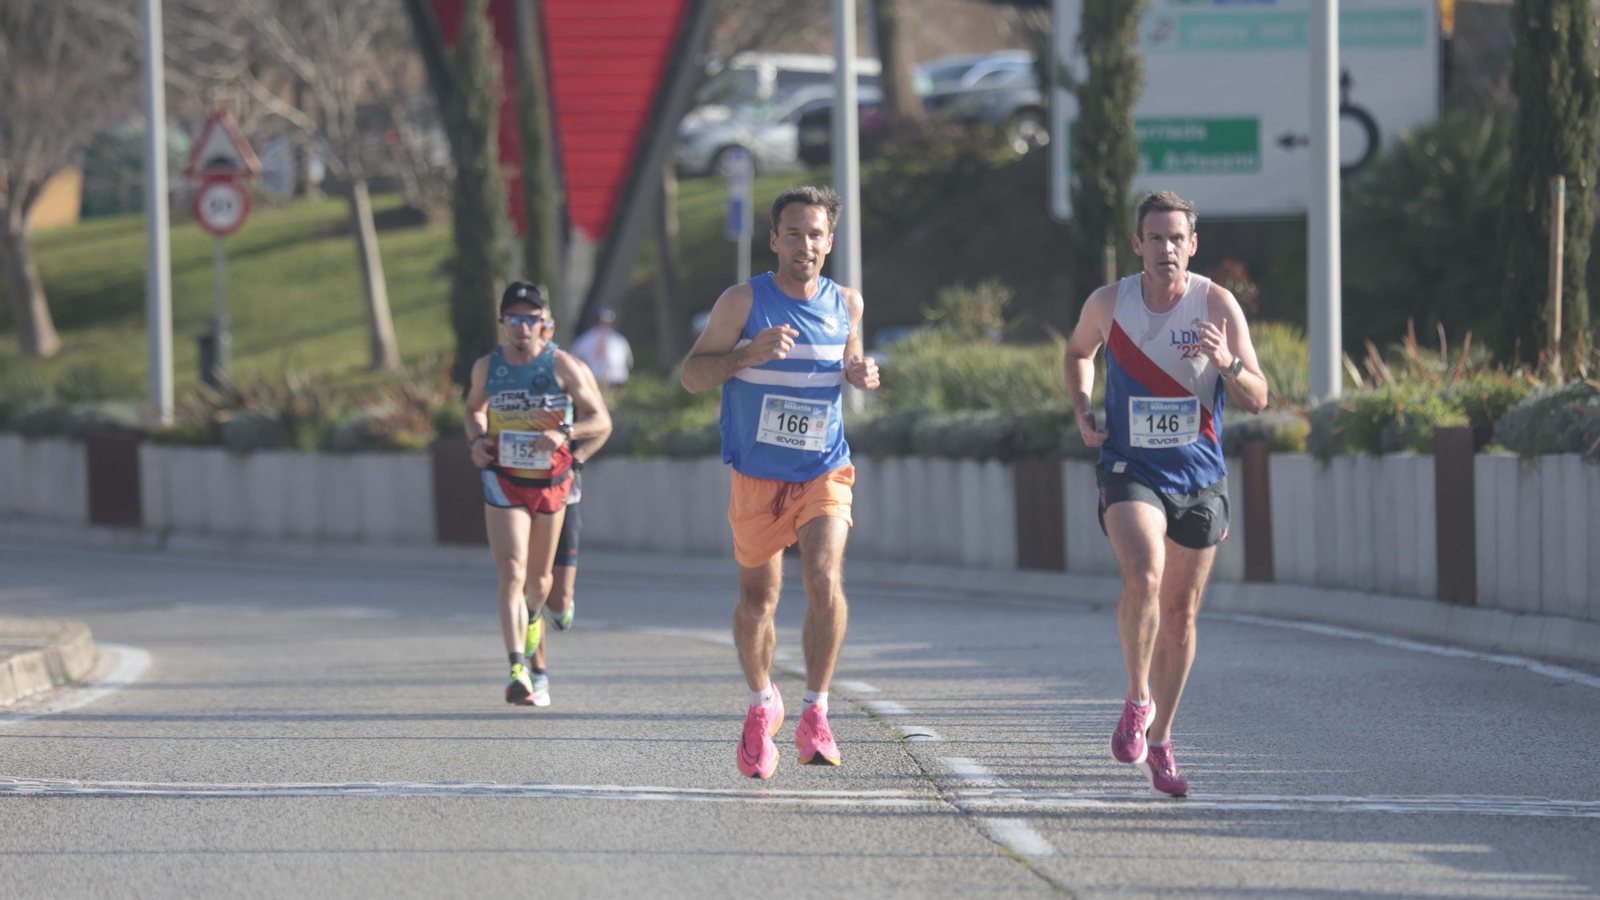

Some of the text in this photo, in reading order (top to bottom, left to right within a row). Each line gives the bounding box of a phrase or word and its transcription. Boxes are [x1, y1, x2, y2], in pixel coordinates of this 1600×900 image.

[777, 413, 809, 434] 166
[1146, 414, 1179, 433] 146
[775, 435, 807, 446] EVOS
[1148, 437, 1180, 445] EVOS
[511, 444, 535, 458] 152
